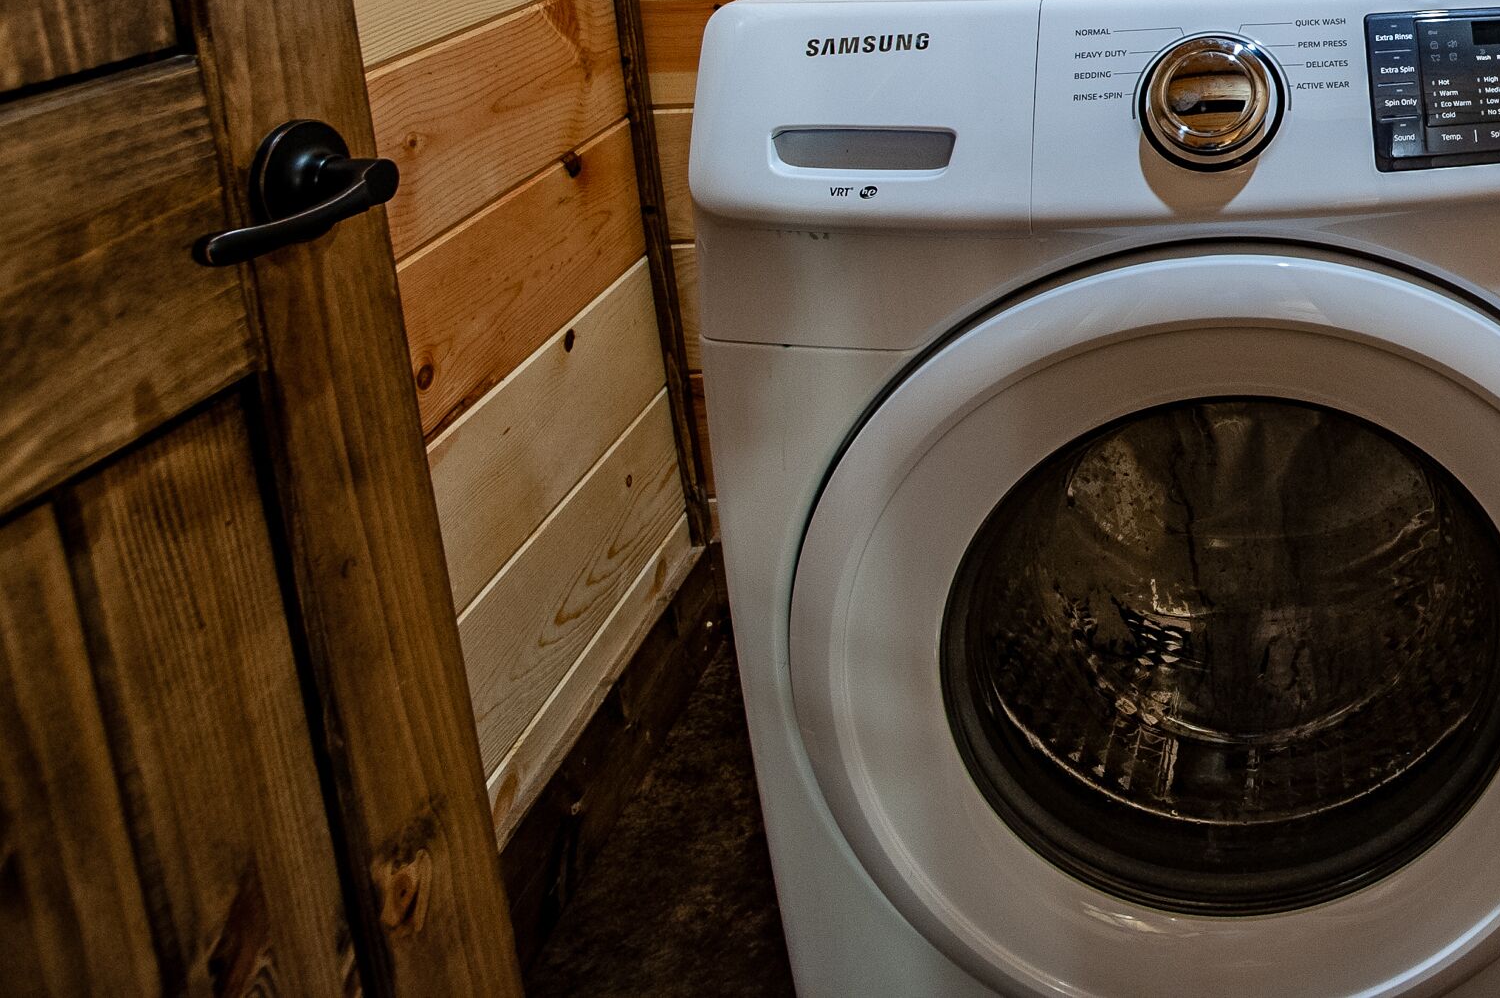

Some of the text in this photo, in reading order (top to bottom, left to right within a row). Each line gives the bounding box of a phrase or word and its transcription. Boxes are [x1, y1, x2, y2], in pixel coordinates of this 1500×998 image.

[1295, 17, 1347, 28] QUICK WASH
[1075, 28, 1112, 37] NORMAL
[1375, 33, 1413, 42] Extra Rinse
[805, 32, 930, 57] SAMSUNG
[1297, 39, 1348, 49] PERM PRESS
[1074, 49, 1128, 60] HEAVY DUTY
[1305, 59, 1349, 68] DELICATES
[1380, 65, 1415, 74] Extra Spin
[1074, 70, 1112, 80] BEDDING
[1296, 80, 1350, 90] ACTIVE WEAR
[1073, 91, 1124, 101] RINSE+SPIN
[1439, 89, 1459, 97] Warm
[1384, 98, 1418, 108] Spin Only
[1441, 111, 1457, 119] Cold
[1393, 133, 1416, 142] Sound
[1441, 133, 1463, 141] Temp.
